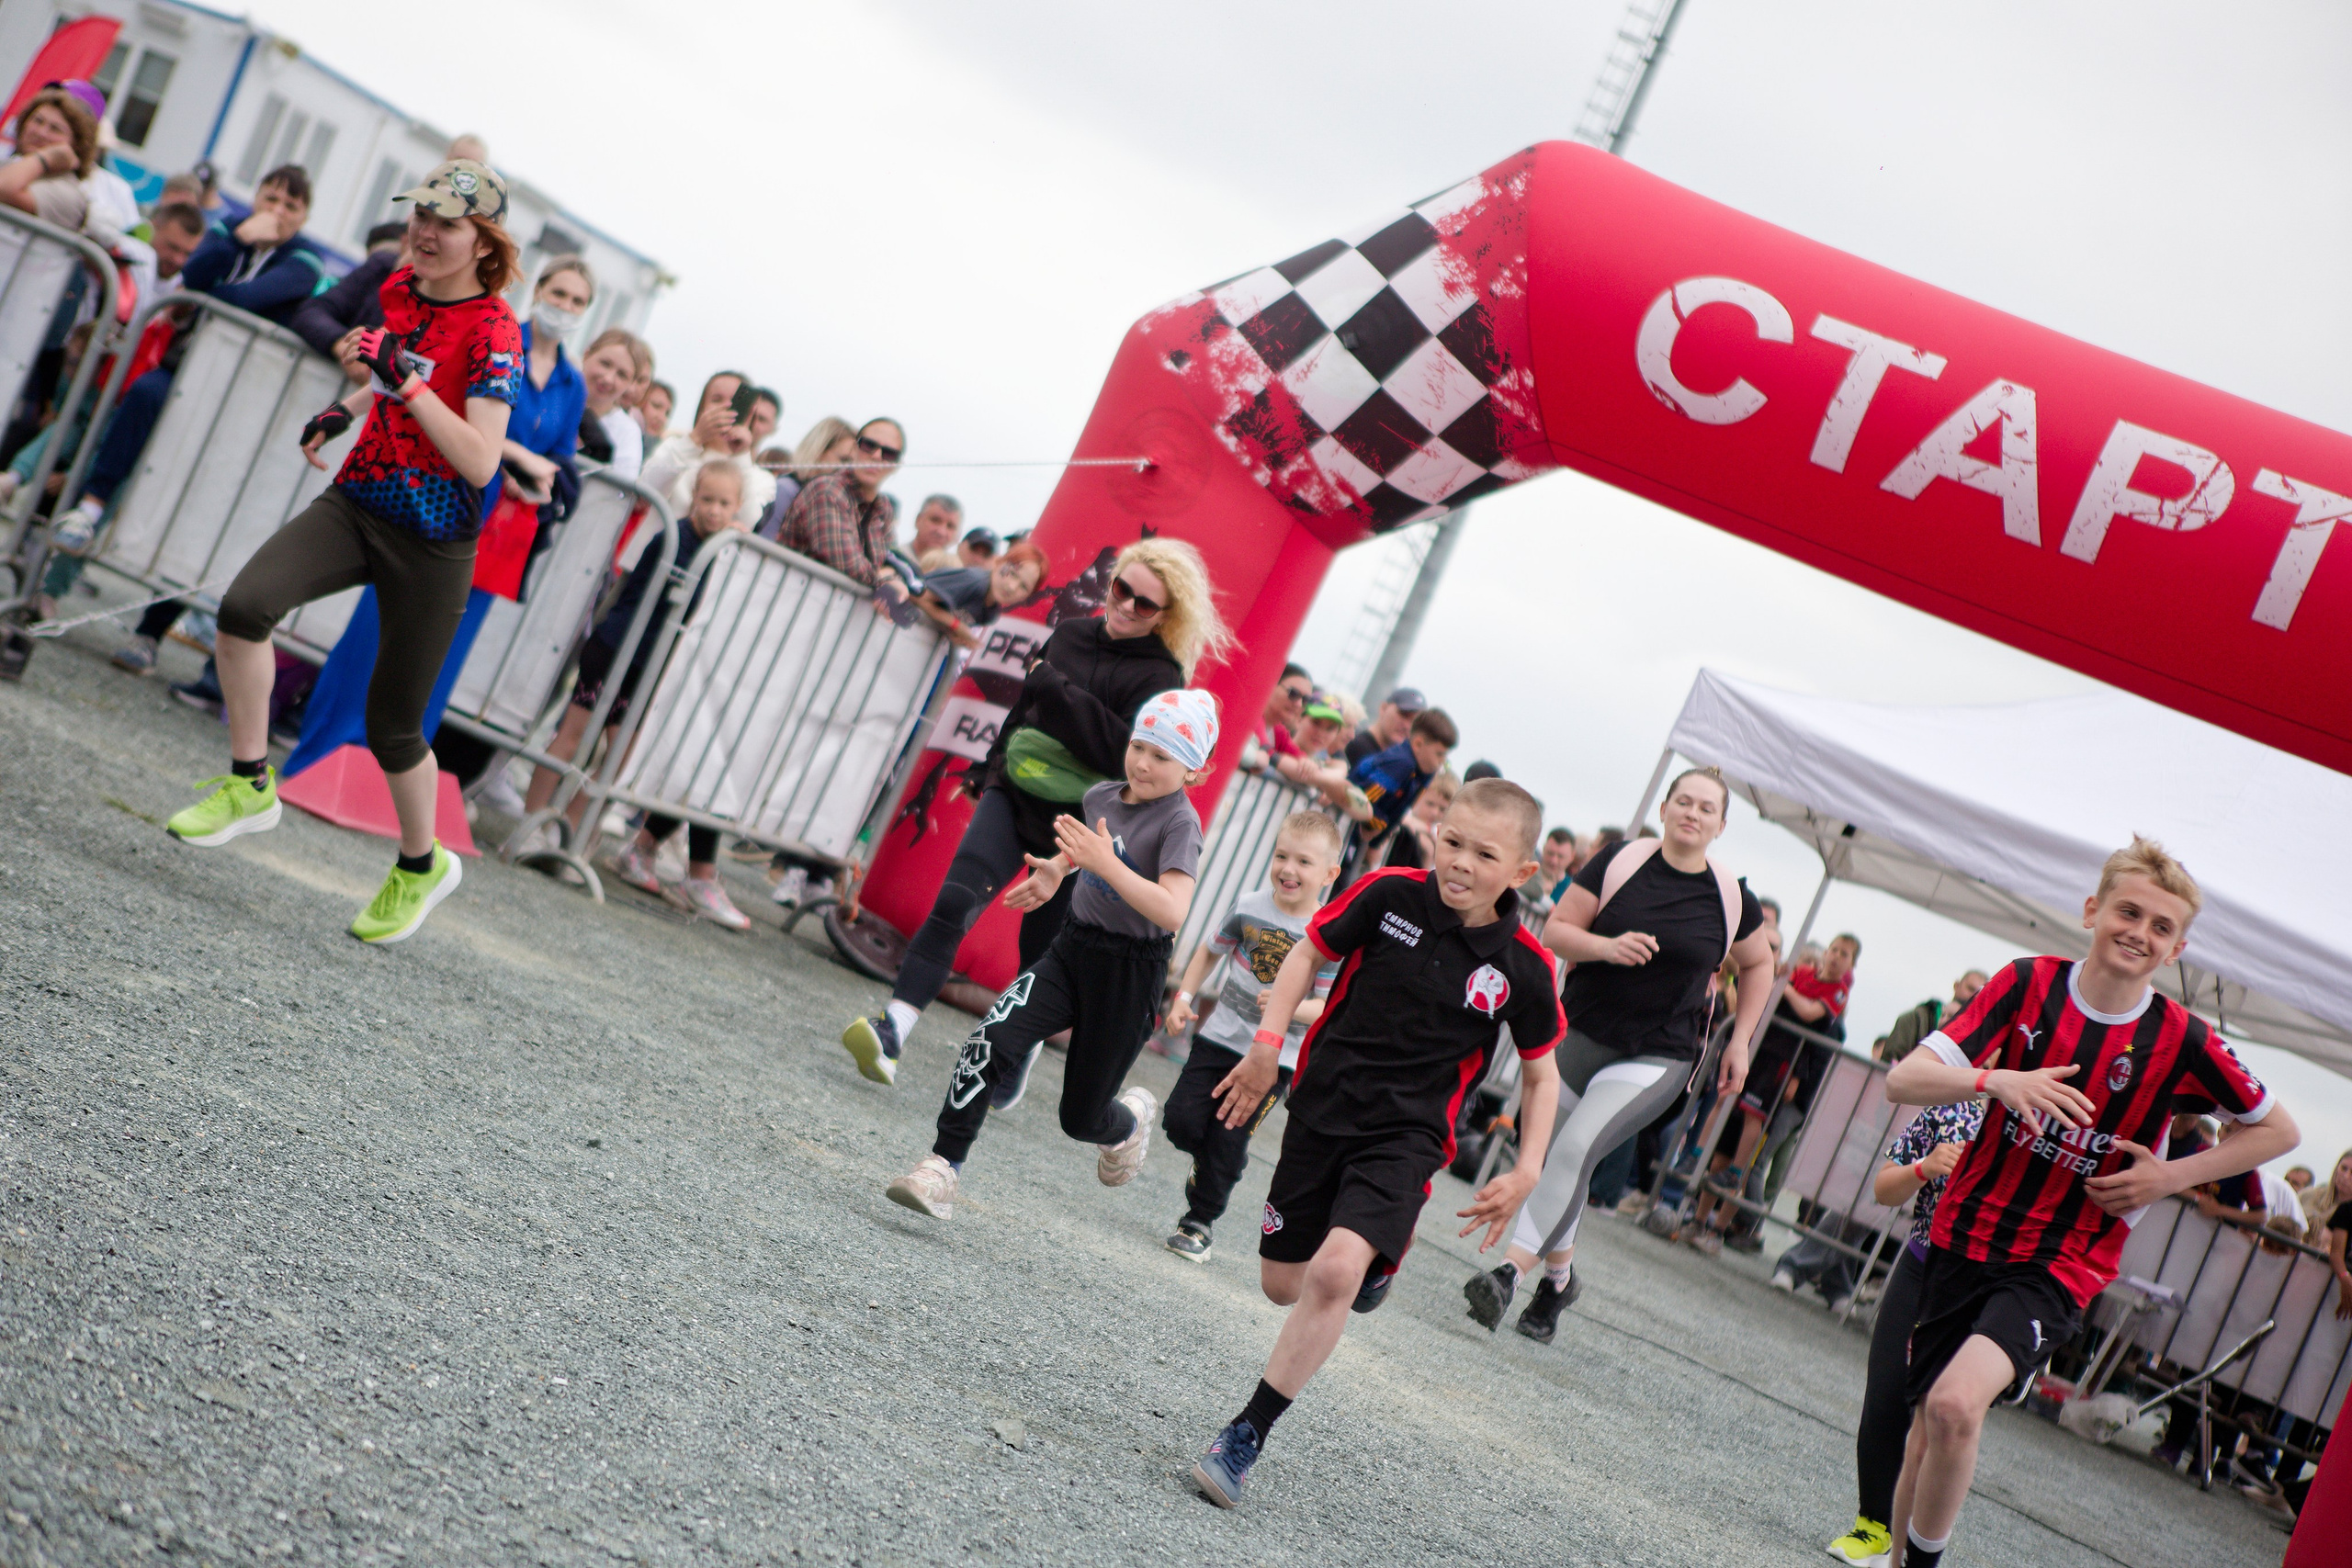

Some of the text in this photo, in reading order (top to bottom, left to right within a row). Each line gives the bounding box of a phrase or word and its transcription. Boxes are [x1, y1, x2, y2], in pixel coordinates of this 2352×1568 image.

[1635, 276, 2352, 632] СТАРТ
[1379, 920, 1419, 947] ТИМОФЕЙ
[1385, 911, 1423, 938] СМИРНОВ
[2005, 1120, 2098, 1177] FLY BETTER
